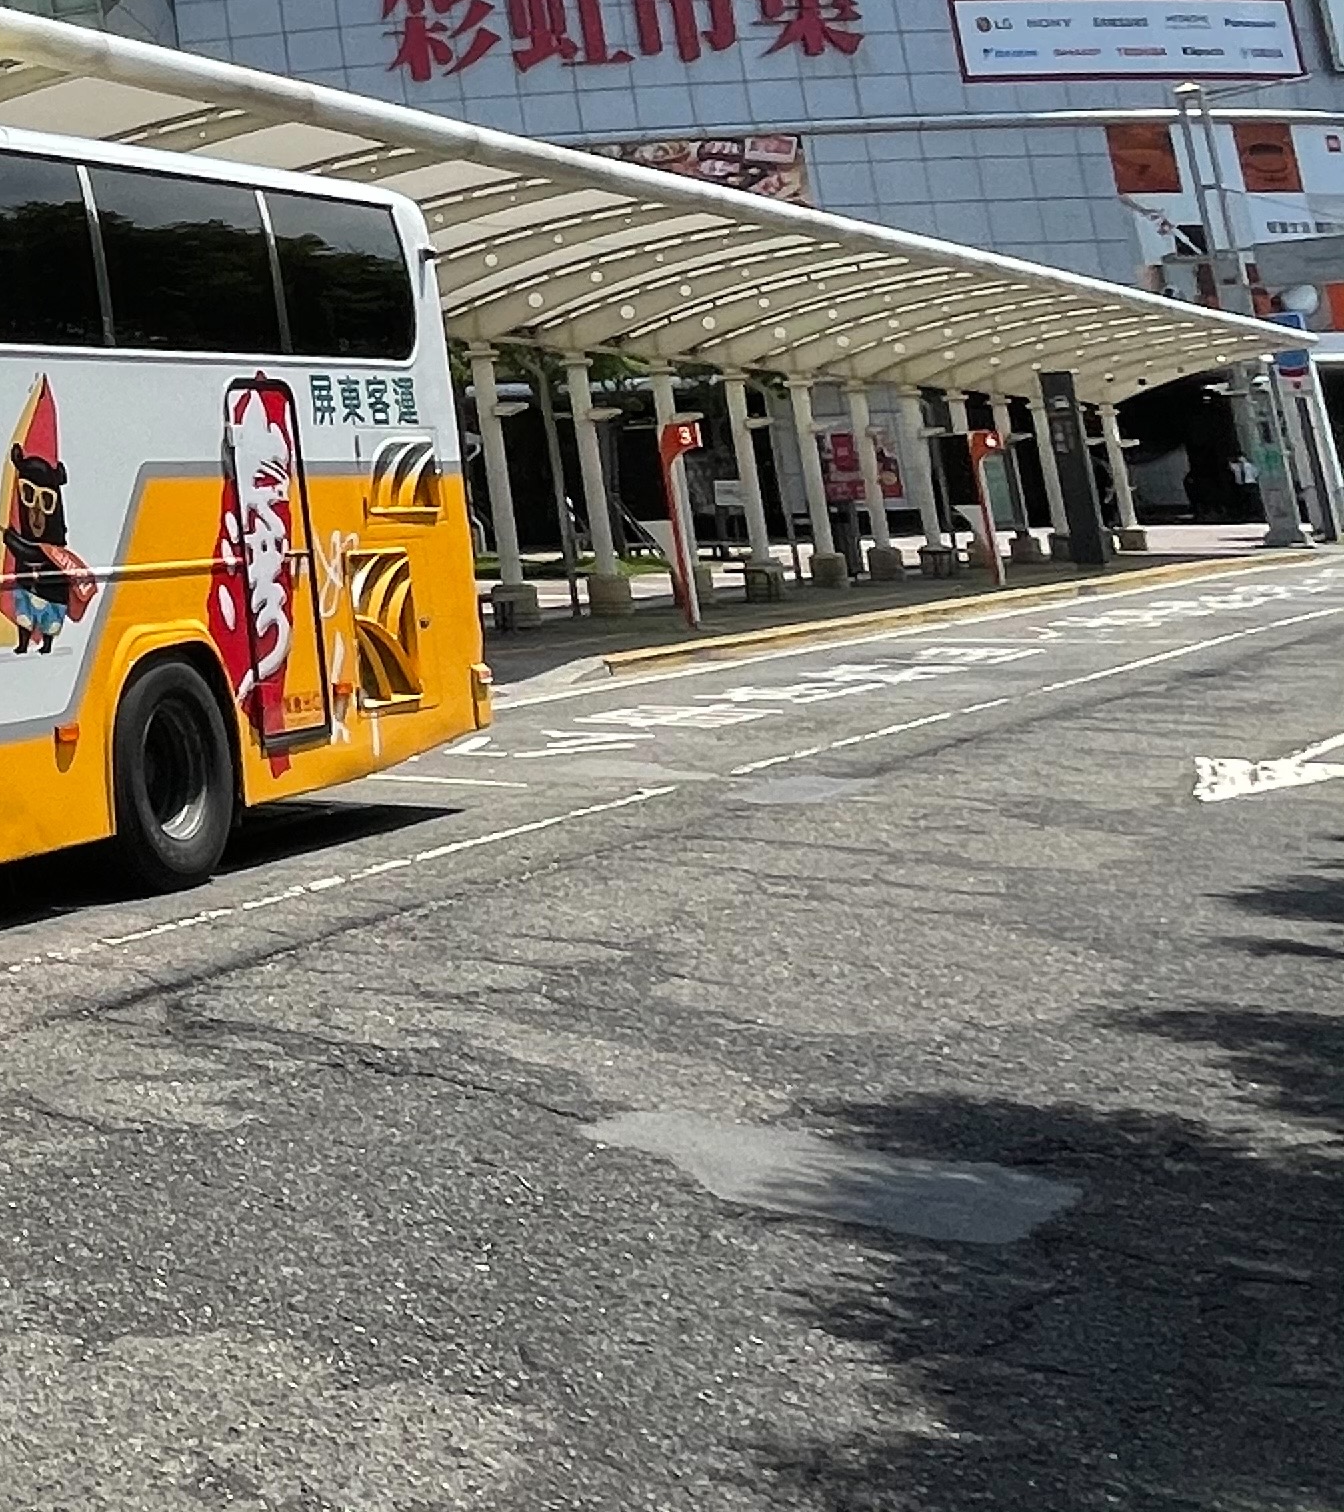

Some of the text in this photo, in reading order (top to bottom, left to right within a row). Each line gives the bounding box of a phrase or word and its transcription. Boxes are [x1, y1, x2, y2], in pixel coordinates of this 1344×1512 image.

[309, 374, 420, 426] 屏東客運
[678, 426, 693, 445] 3
